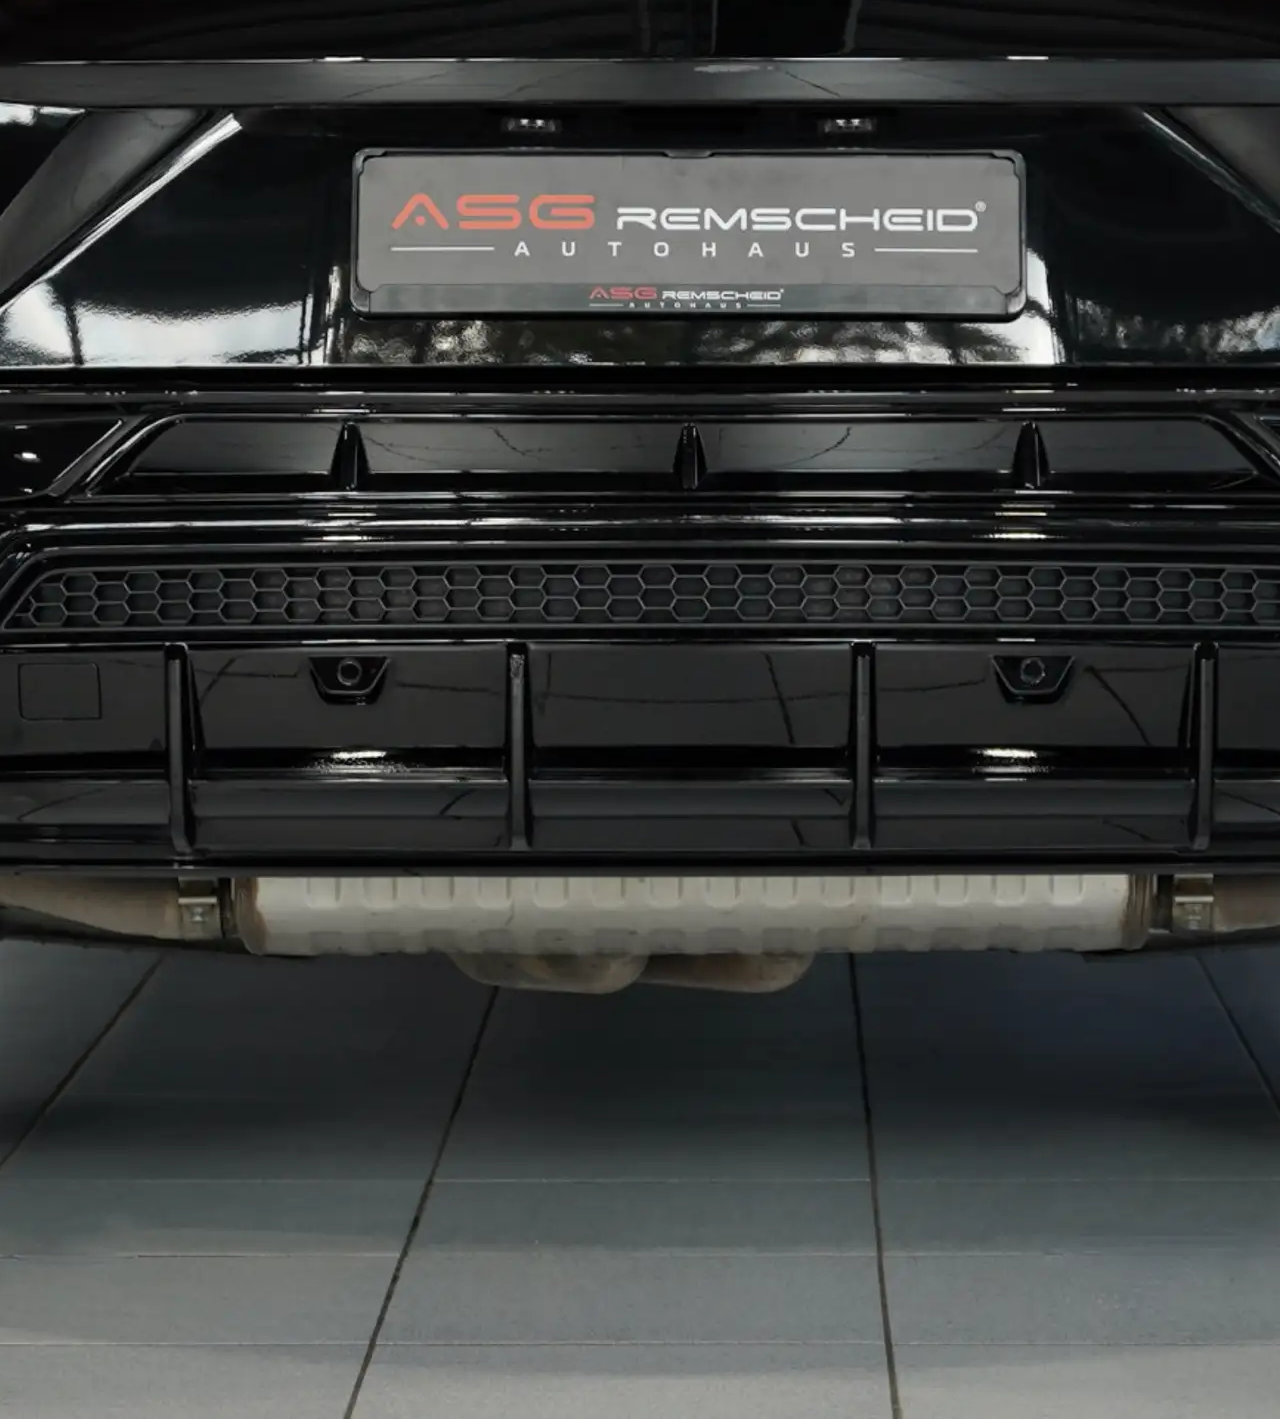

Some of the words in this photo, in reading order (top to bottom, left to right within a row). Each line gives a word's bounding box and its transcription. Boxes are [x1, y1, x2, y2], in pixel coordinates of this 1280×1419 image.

[391, 193, 596, 230] ASG
[514, 241, 856, 258] AUTOHAUS
[588, 287, 657, 300] ASG
